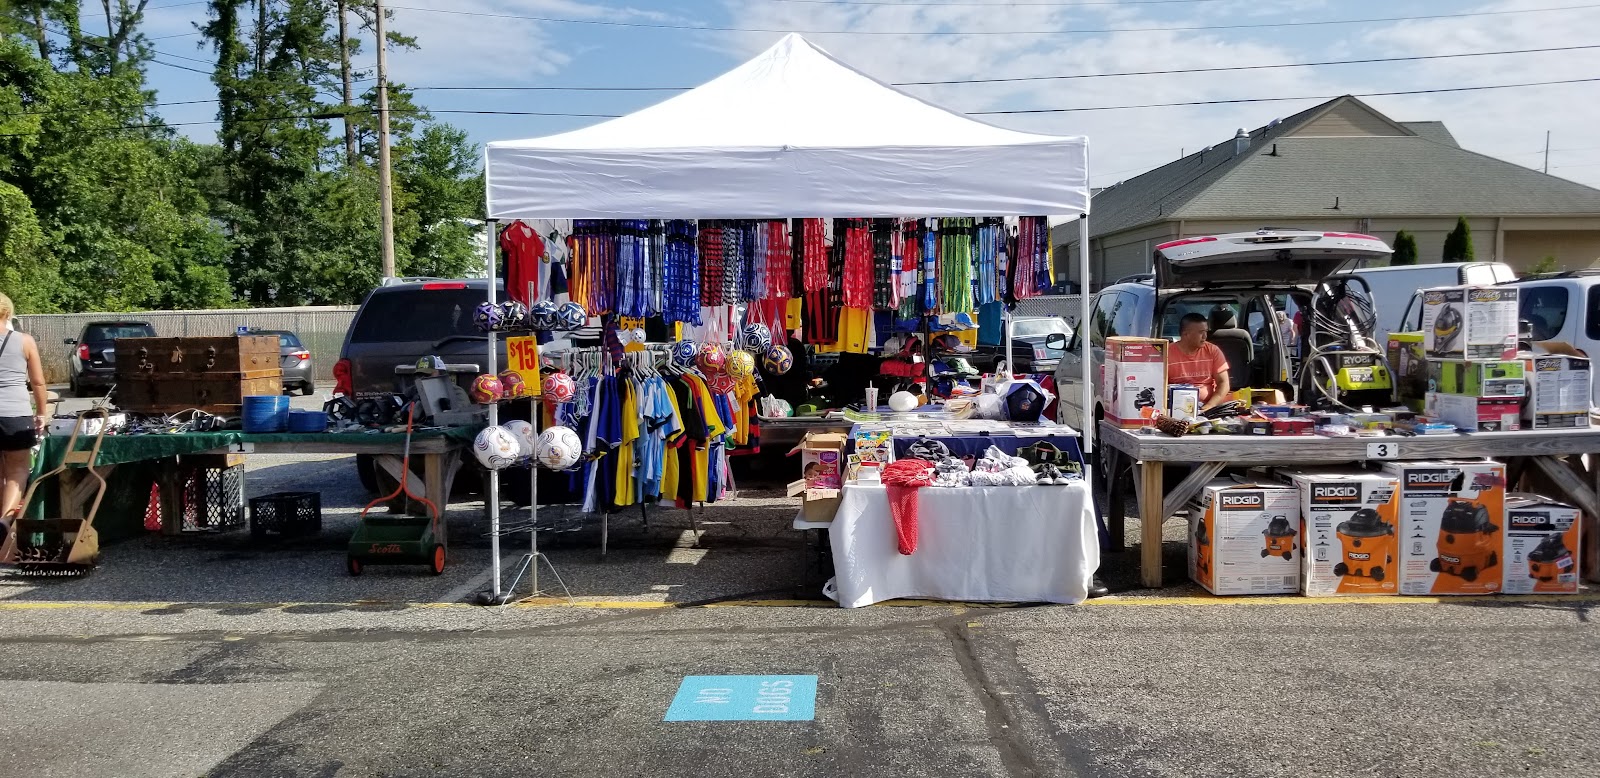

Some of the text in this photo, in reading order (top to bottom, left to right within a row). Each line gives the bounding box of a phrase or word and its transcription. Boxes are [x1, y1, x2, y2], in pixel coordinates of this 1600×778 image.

[510, 340, 534, 370] $15
[1343, 355, 1371, 364] RYOBI
[237, 441, 246, 452] 1
[1377, 444, 1388, 457] 3
[1408, 473, 1453, 483] RIDGID
[1314, 487, 1358, 497] RIDGID
[1222, 496, 1261, 505] RIDGID
[1512, 516, 1546, 524] RIDGID
[368, 543, 401, 553] Scotts
[693, 688, 733, 704] NO
[752, 680, 794, 714] DOGS
